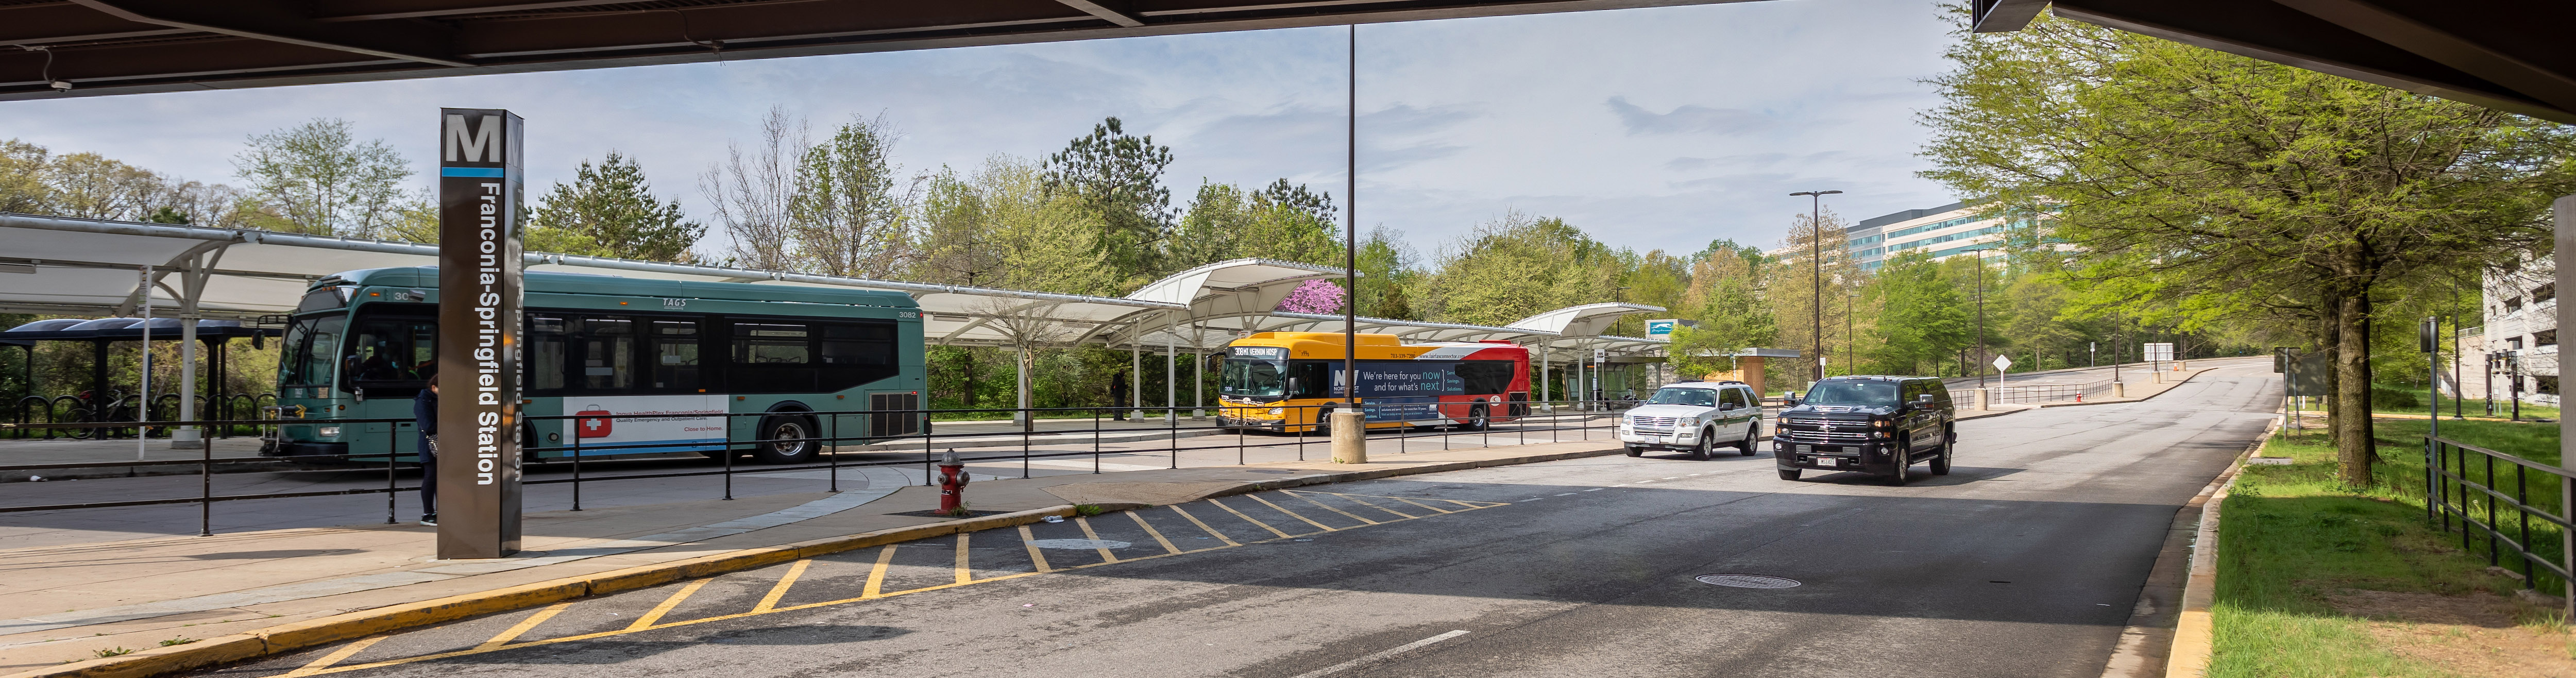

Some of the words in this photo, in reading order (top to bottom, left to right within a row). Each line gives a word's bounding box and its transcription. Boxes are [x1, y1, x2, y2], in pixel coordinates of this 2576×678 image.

[446, 114, 500, 162] M
[474, 182, 500, 405] Franconia-Springfield
[515, 188, 524, 404] Franconia-Springfield
[663, 298, 686, 306] TAGS
[1235, 347, 1243, 355] 308
[1363, 371, 1382, 380] We're
[1384, 371, 1398, 380] here
[1400, 371, 1409, 380] for
[1410, 374, 1421, 382] you
[1422, 371, 1440, 380] now
[1374, 382, 1386, 391] and
[1387, 382, 1397, 391] for
[1398, 382, 1418, 391] what's
[1420, 381, 1439, 391] next
[477, 412, 499, 485] Station
